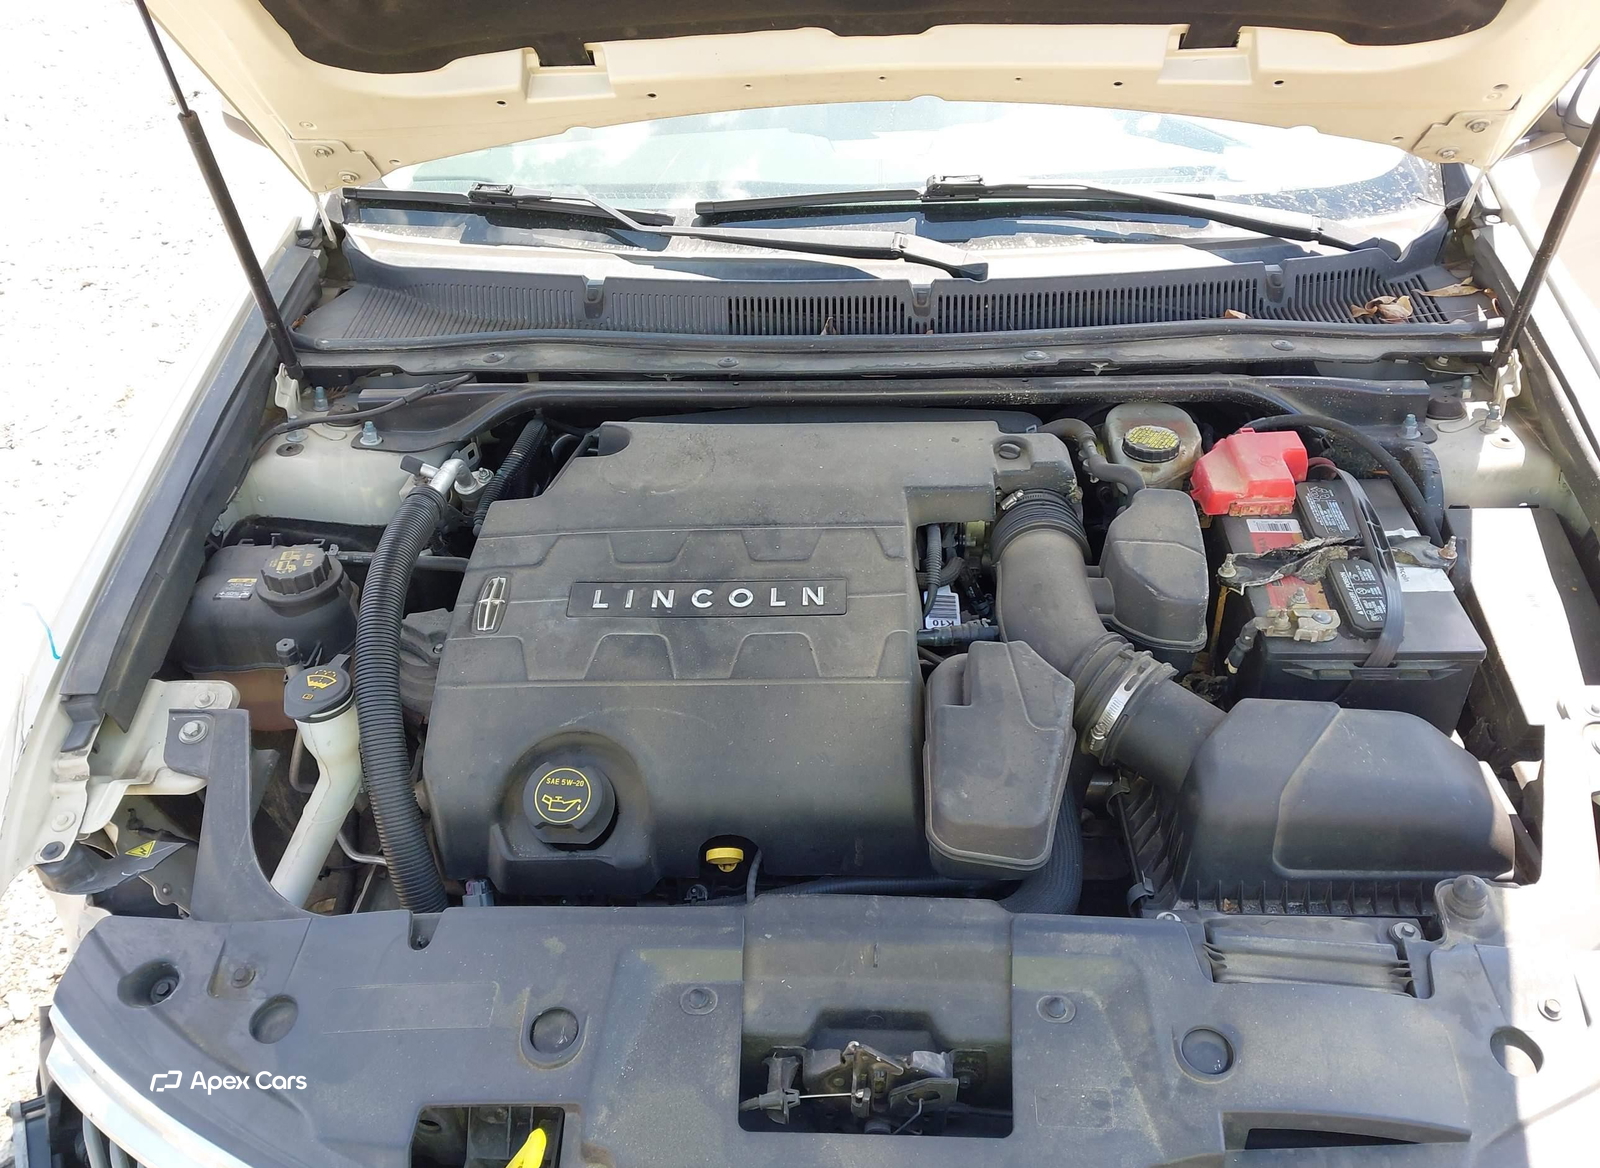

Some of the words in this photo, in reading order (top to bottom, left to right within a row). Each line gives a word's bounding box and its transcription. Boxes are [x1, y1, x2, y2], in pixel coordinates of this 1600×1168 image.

[1400, 567, 1410, 582] ncoln
[592, 586, 825, 609] LINCOLN
[932, 619, 955, 627] K10
[545, 777, 560, 785] SAE
[561, 778, 585, 787] 5W-20
